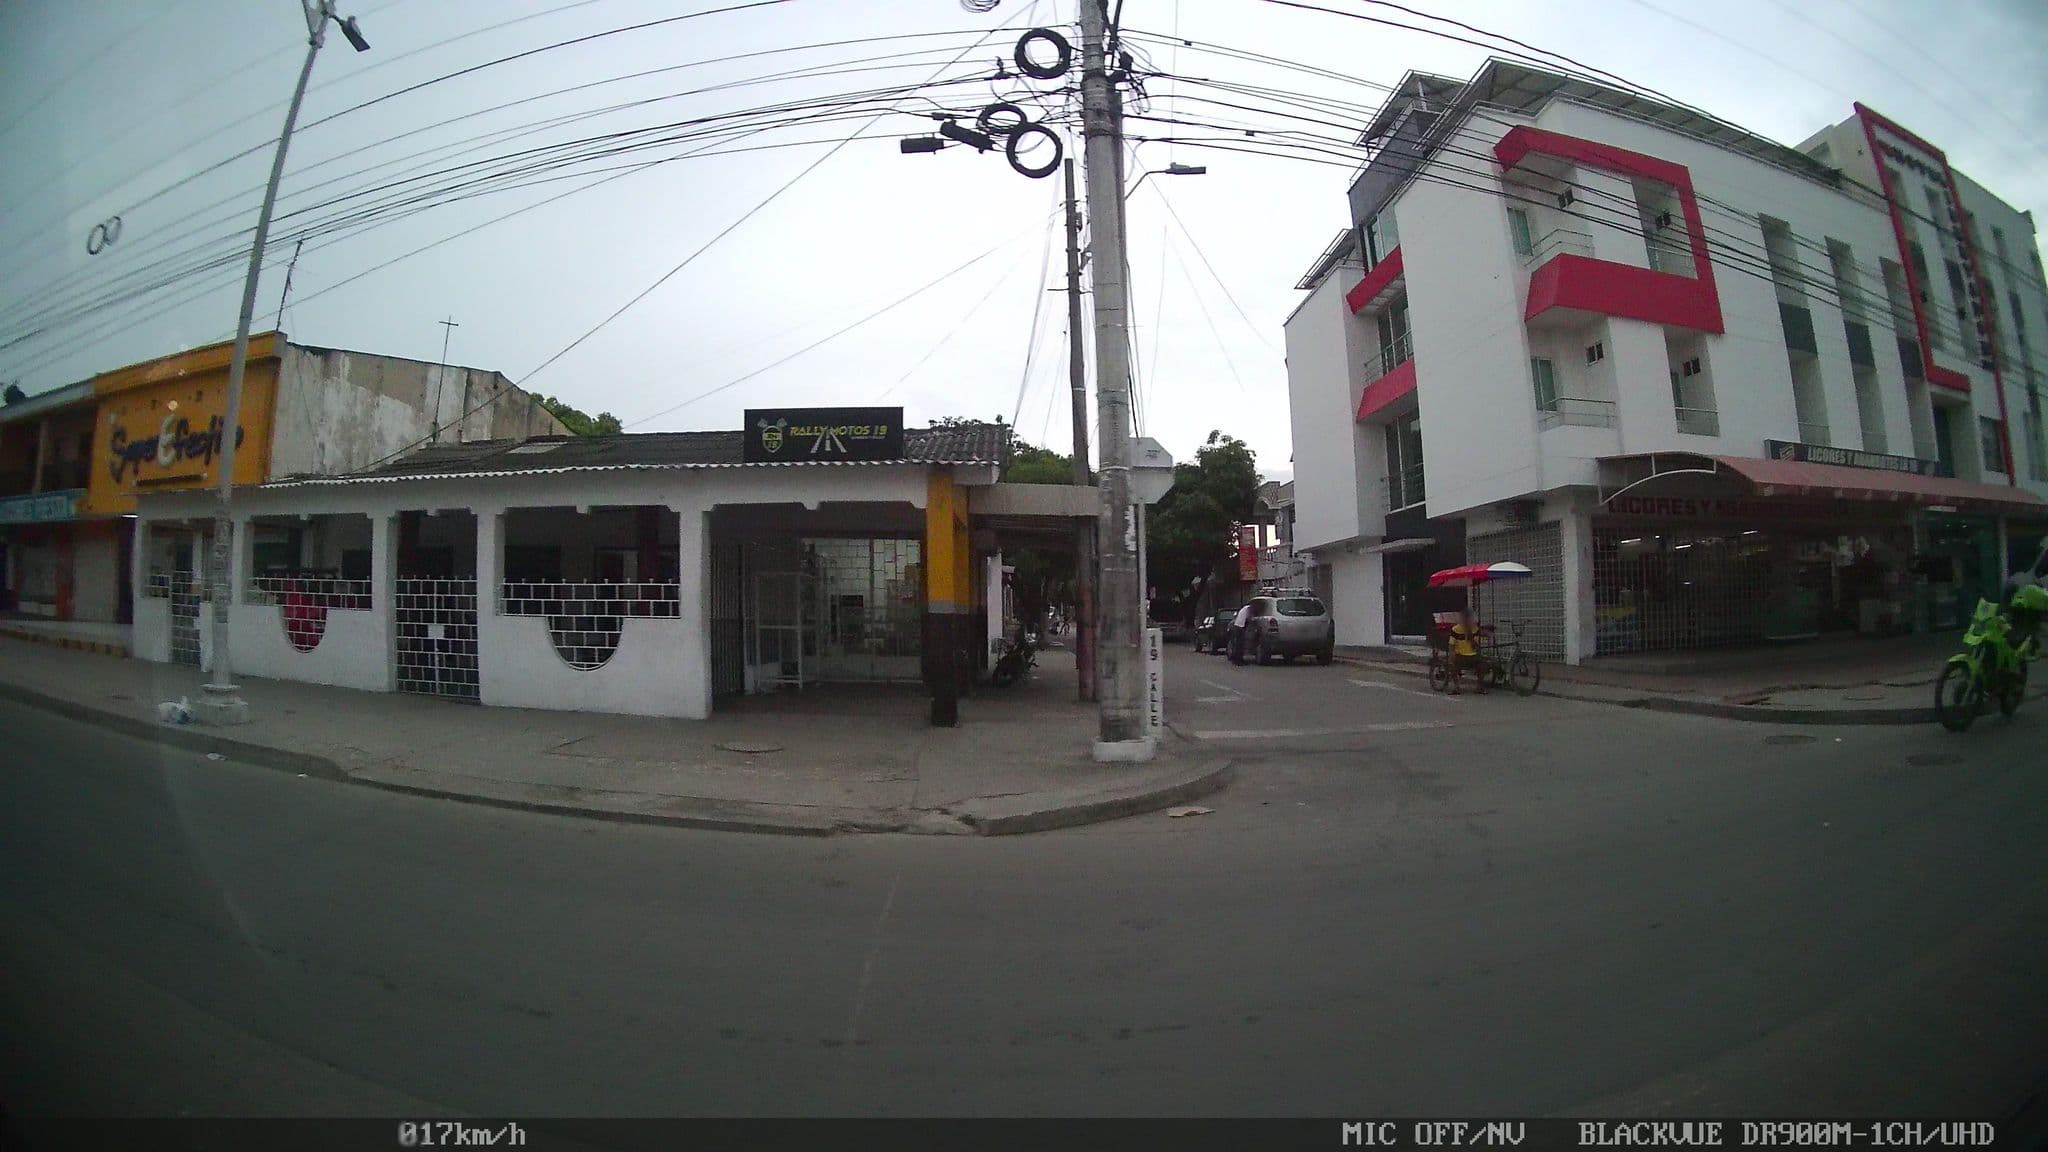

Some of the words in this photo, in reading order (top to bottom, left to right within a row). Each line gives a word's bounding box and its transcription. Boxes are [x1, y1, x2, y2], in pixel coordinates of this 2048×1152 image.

[790, 426, 827, 437] RALLY
[830, 425, 871, 436] MOTOS
[874, 425, 889, 436] 19
[1807, 446, 1846, 464] LICORES
[1150, 635, 1158, 661] 19
[1150, 672, 1158, 727] CALLE
